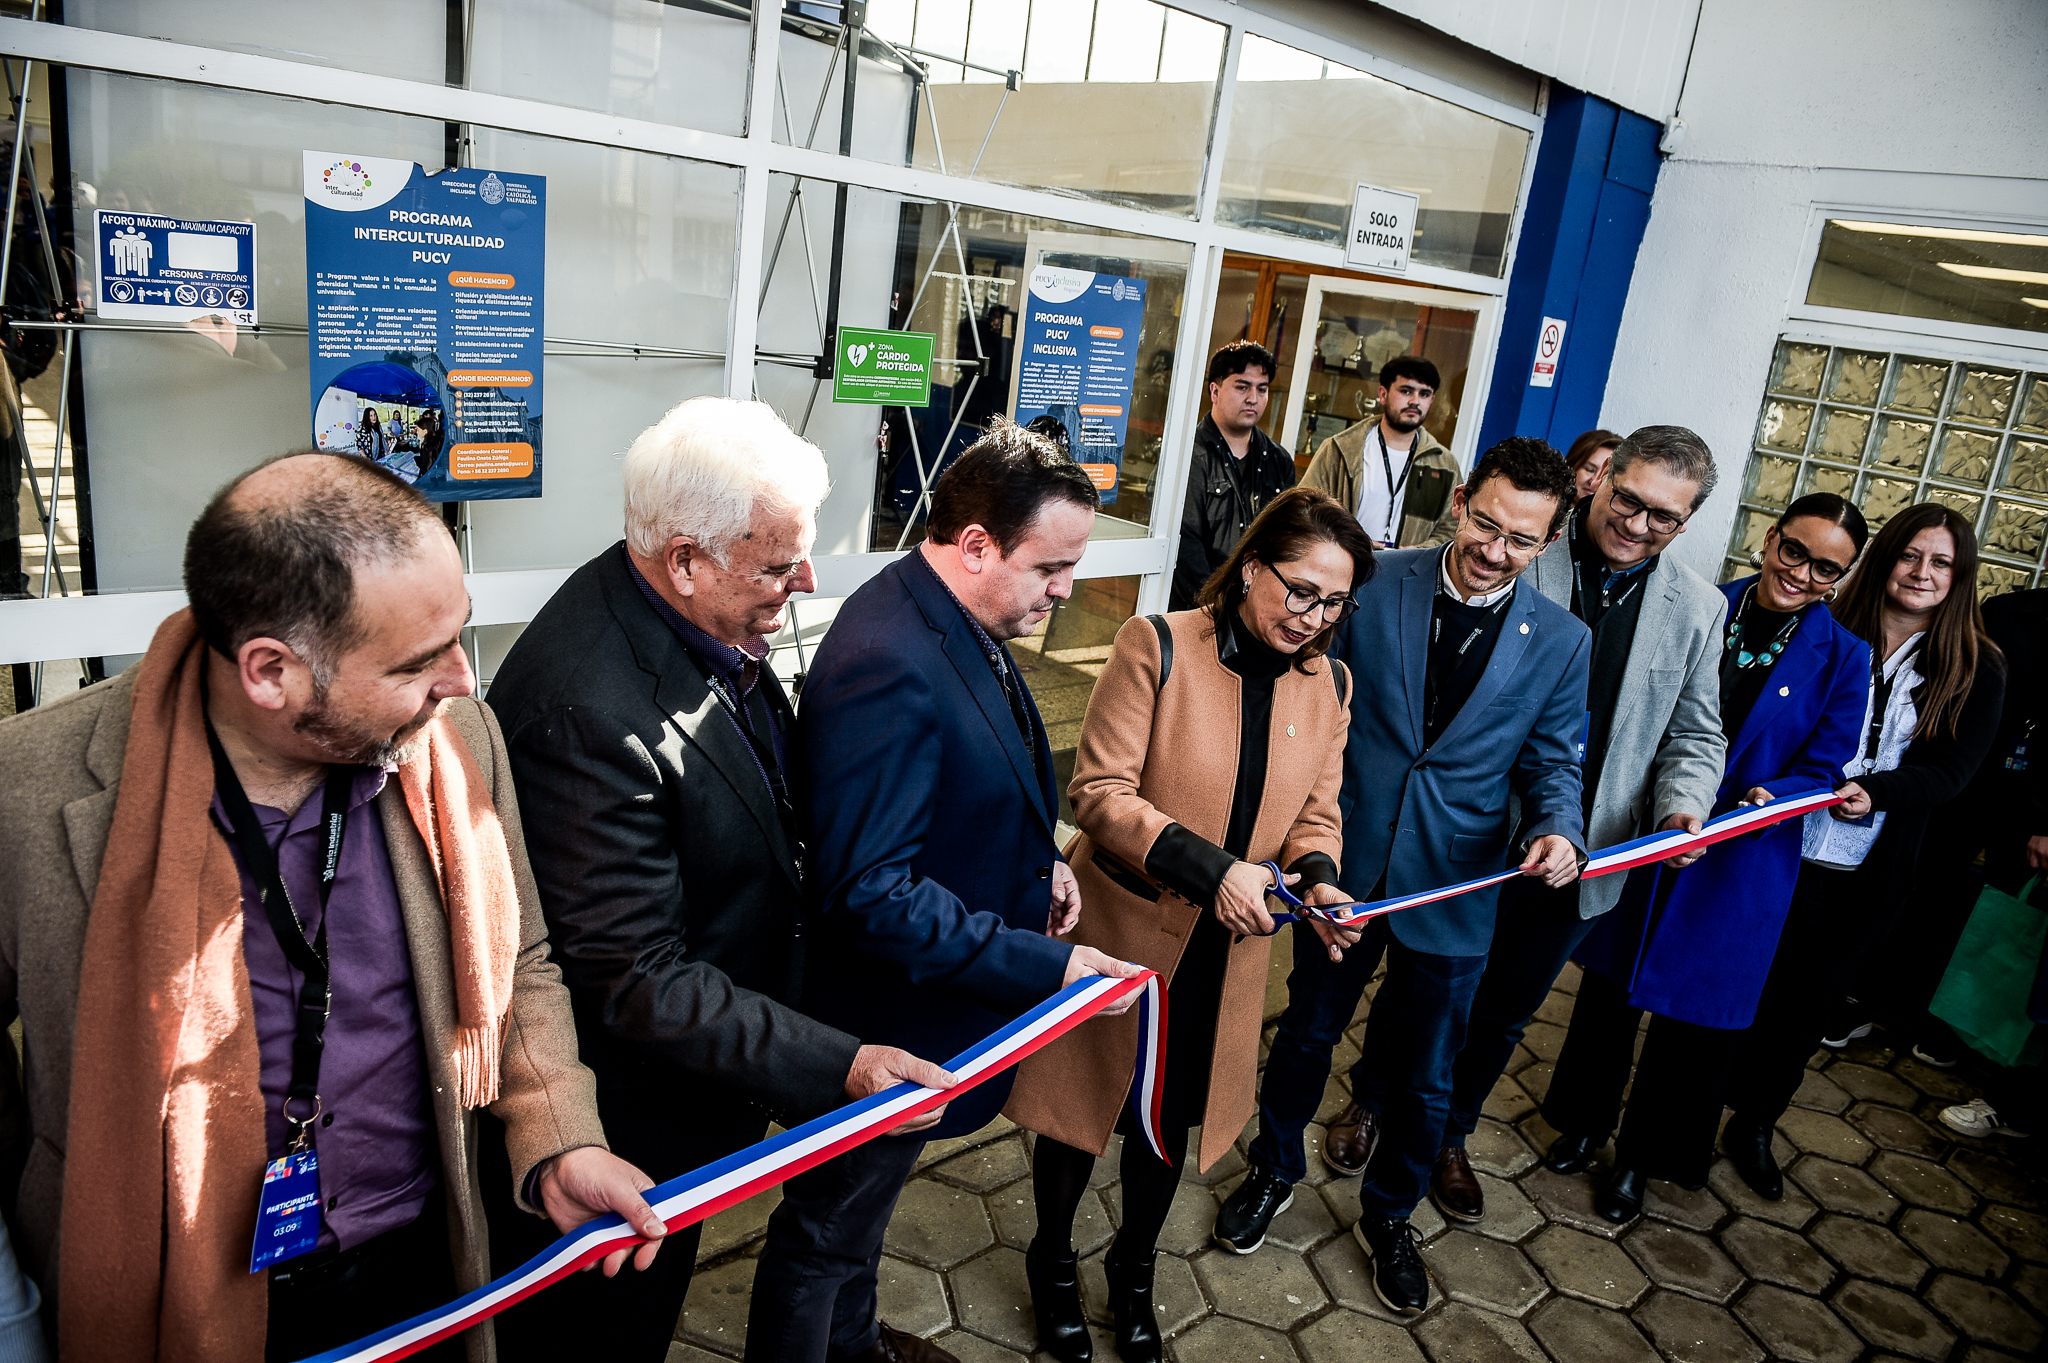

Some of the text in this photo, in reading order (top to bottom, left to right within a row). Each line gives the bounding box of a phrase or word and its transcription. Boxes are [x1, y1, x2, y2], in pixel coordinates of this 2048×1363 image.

[102, 214, 135, 226] AFORO
[181, 222, 215, 233] MAXIMUM
[217, 224, 250, 235] CAPACITY
[389, 210, 472, 228] PROGRAMA
[1370, 211, 1397, 228] SOLO
[354, 227, 505, 249] INTERCULTURALIDAD
[1357, 230, 1403, 249] ENTRADA
[412, 251, 451, 264] PUCV
[159, 270, 247, 283] PERSONAS PERSONS
[234, 311, 253, 324] ist
[1035, 312, 1083, 326] PROGRAMA
[1046, 329, 1069, 340] PUCV
[877, 351, 910, 361] CARDIO
[1033, 343, 1077, 356] INCLUSIVA
[876, 361, 924, 372] PROTEGIDA
[328, 813, 338, 849] Industrial
[266, 1192, 315, 1215] PARTICIPANTE
[273, 1223, 297, 1237] 03.09
